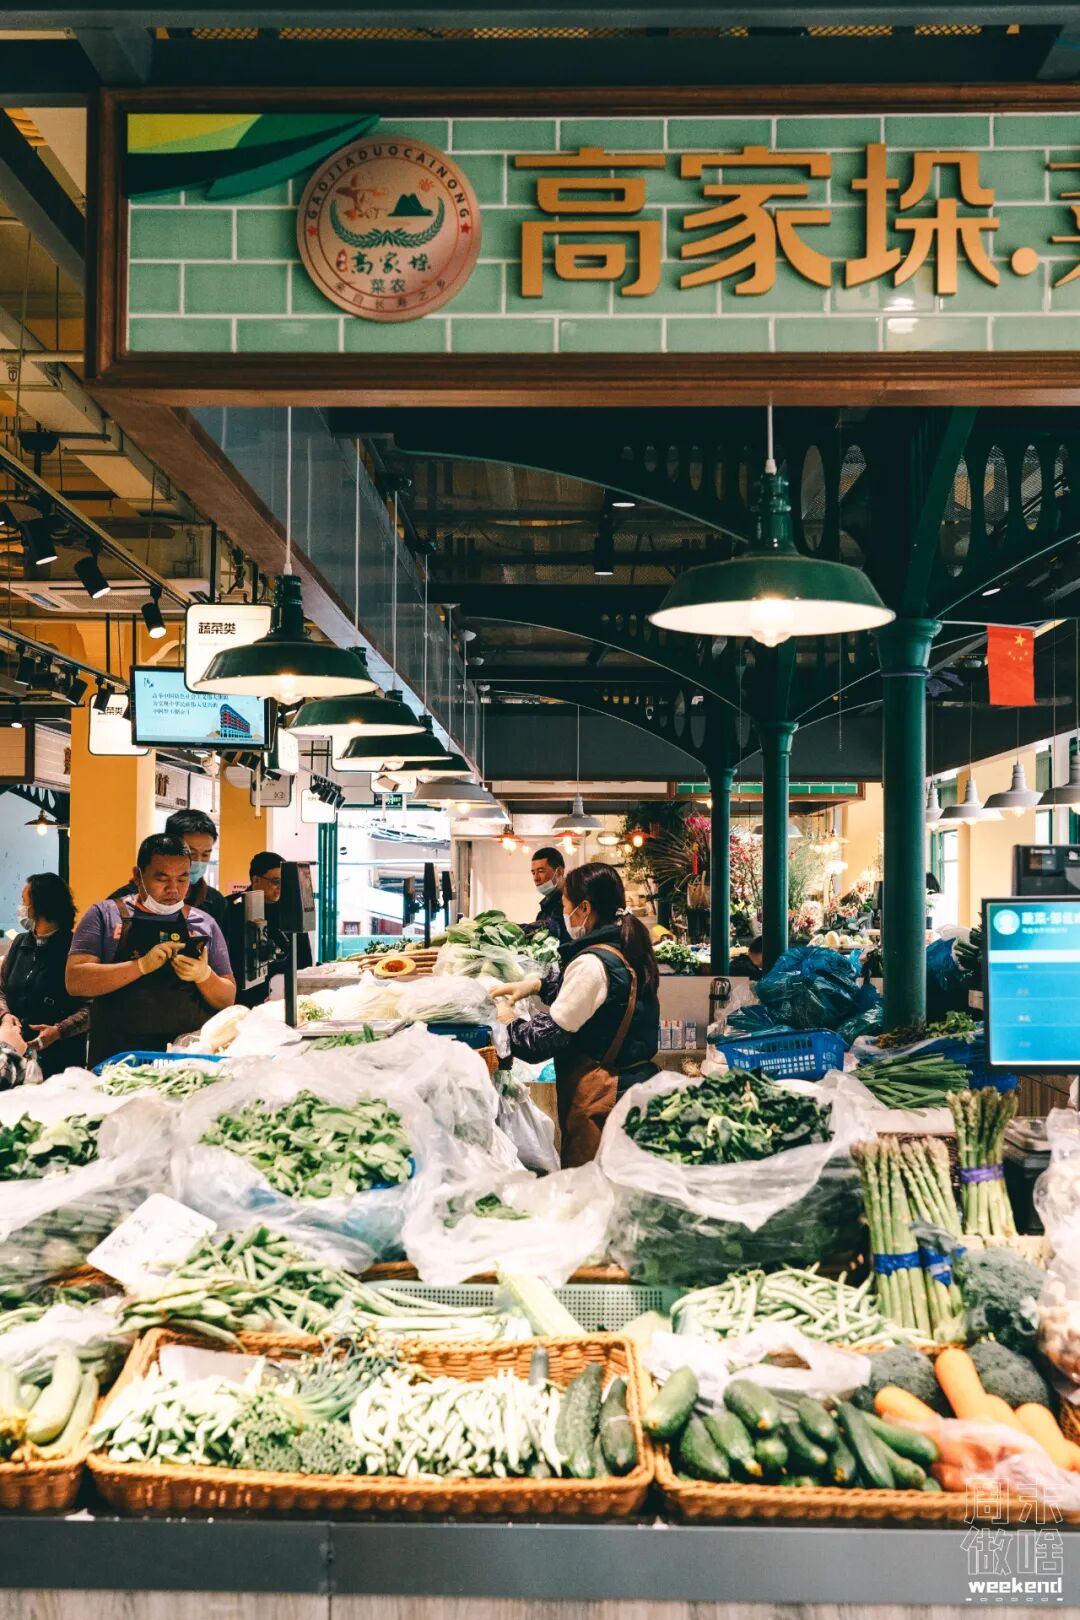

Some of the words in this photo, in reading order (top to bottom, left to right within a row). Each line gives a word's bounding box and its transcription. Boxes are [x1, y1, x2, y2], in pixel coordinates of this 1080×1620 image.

[307, 145, 470, 220] GAOJIADUOCAINONG
[514, 143, 1080, 298] 高家垛·
[370, 278, 406, 293] 菜农
[198, 622, 236, 635] 蔬菜类
[98, 706, 123, 716] 菜类
